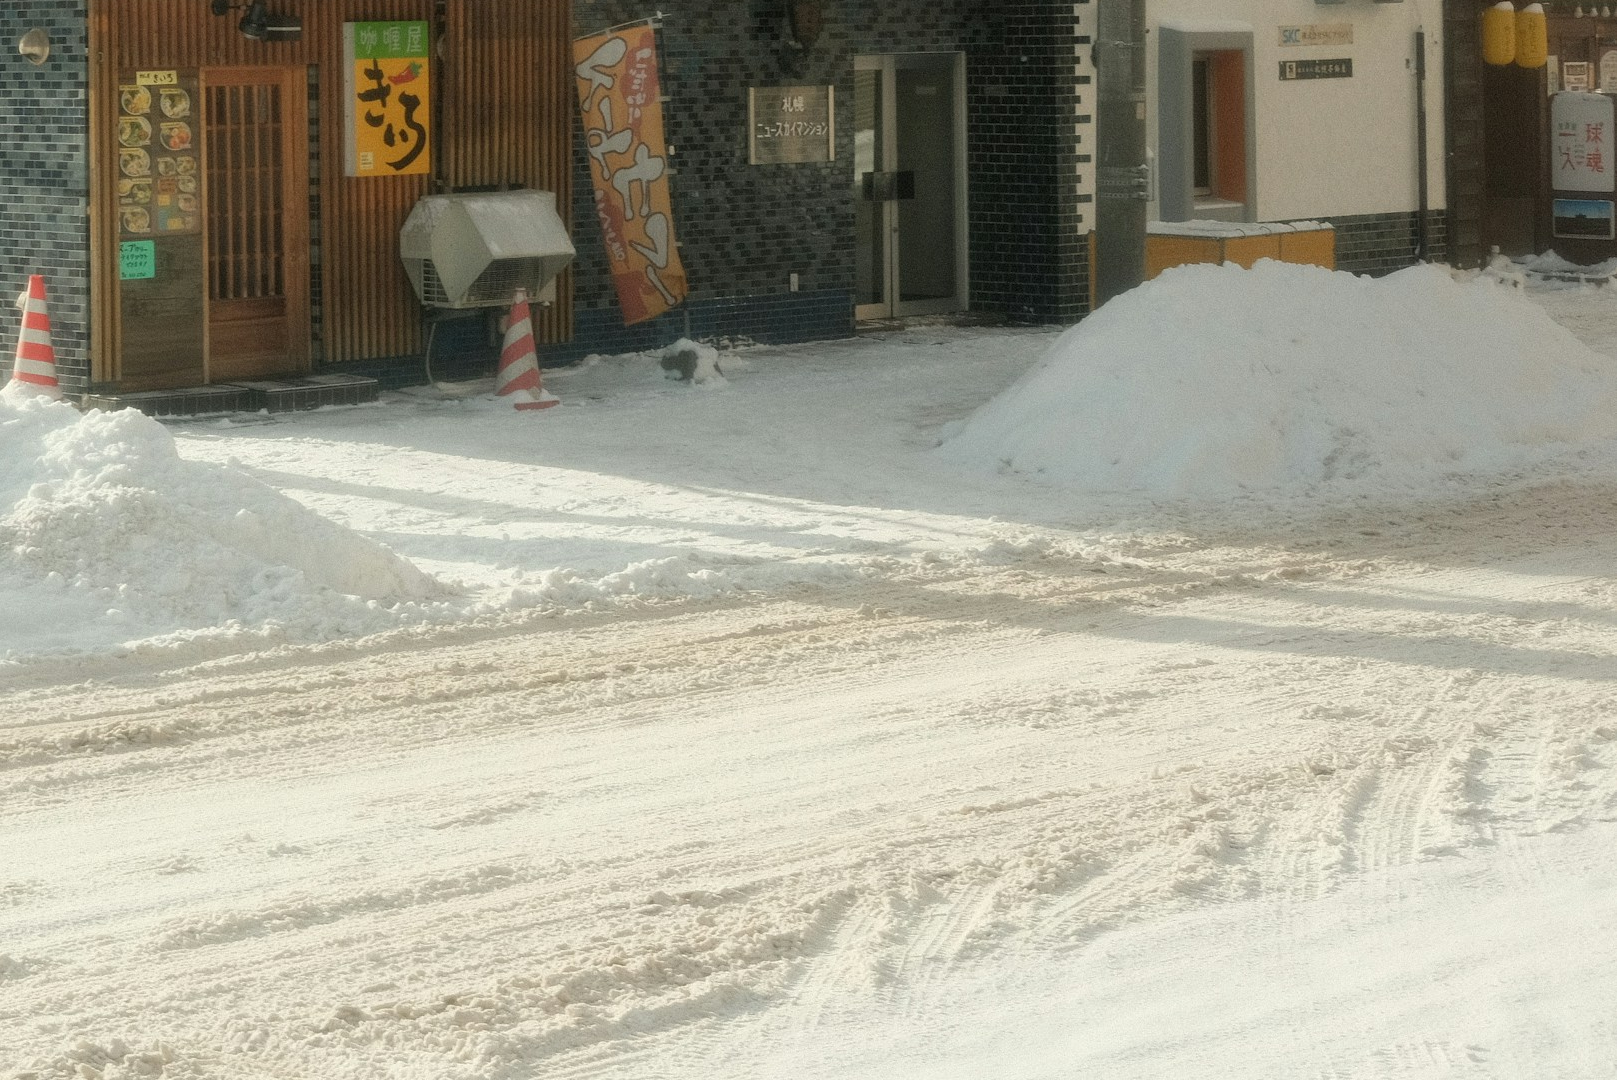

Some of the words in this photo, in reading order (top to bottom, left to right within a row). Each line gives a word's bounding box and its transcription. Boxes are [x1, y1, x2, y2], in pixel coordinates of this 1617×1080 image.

[782, 96, 805, 113] 札幌
[357, 58, 427, 171] きいろ
[756, 121, 829, 138] ニュースカイマンション
